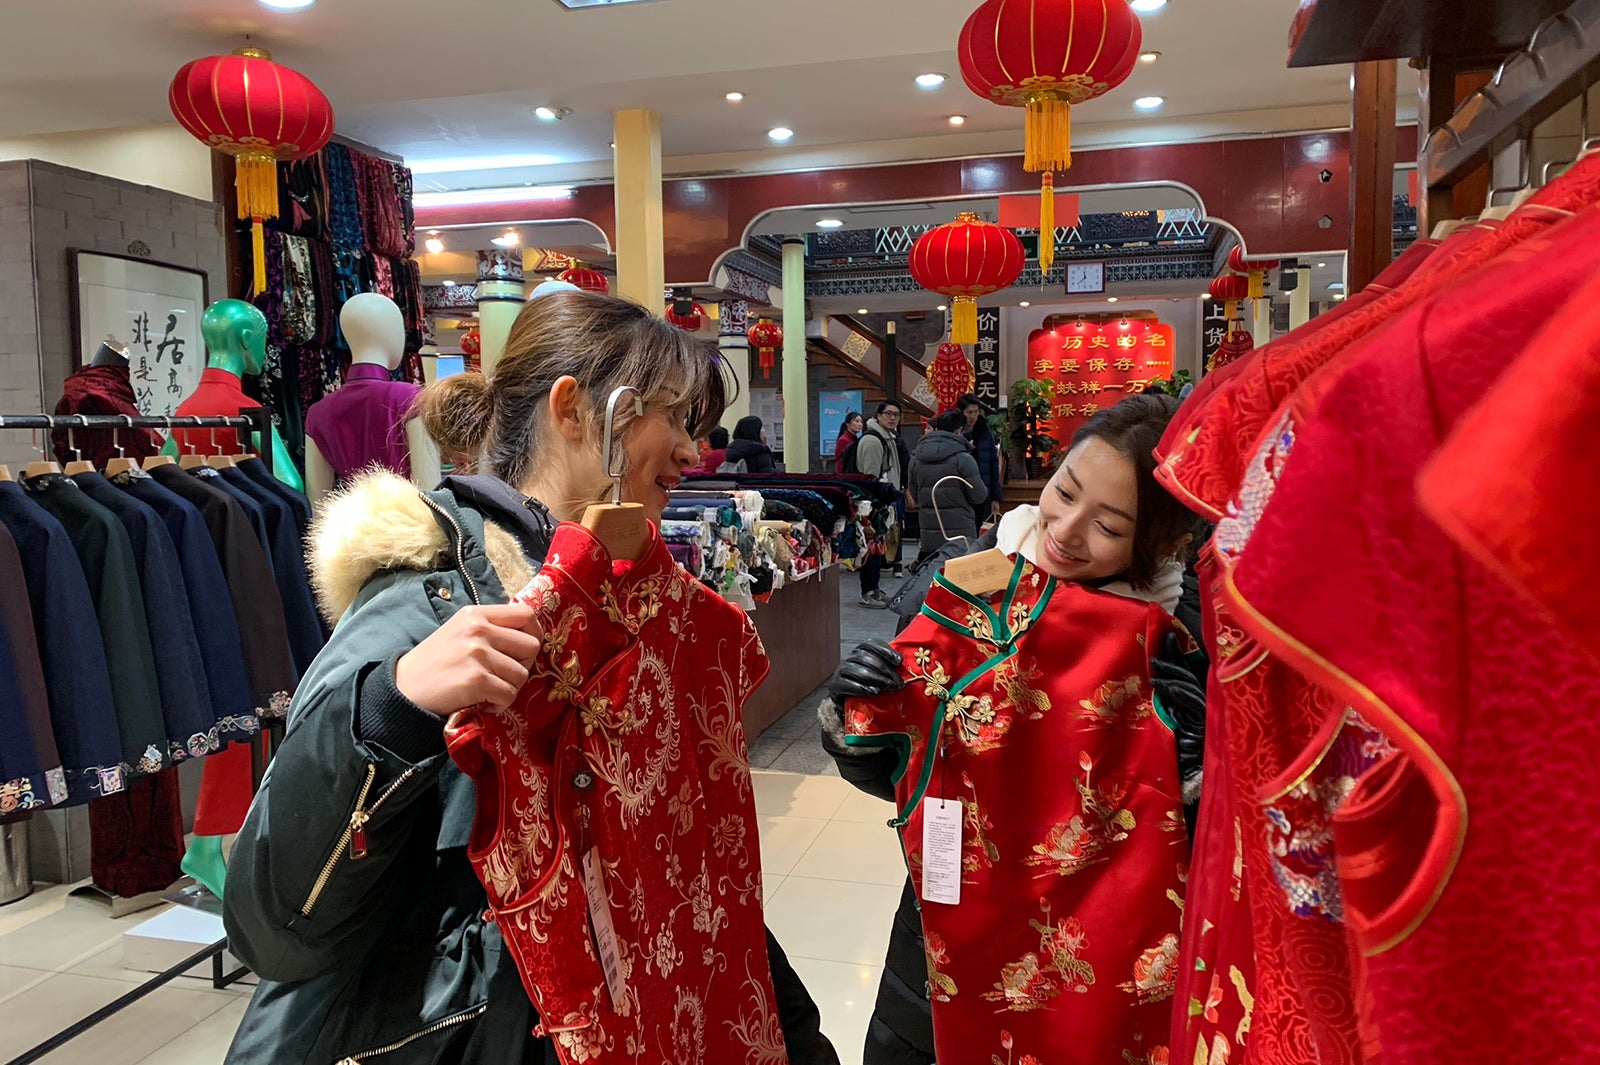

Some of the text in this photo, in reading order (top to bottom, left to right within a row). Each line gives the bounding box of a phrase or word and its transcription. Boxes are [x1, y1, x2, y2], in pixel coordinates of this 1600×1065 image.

[1205, 304, 1228, 357] 上货
[1062, 333, 1166, 349] 历史的名
[977, 312, 998, 411] 价童叟无
[1048, 380, 1152, 395] 蚨祥一万
[1048, 403, 1098, 417] 保存
